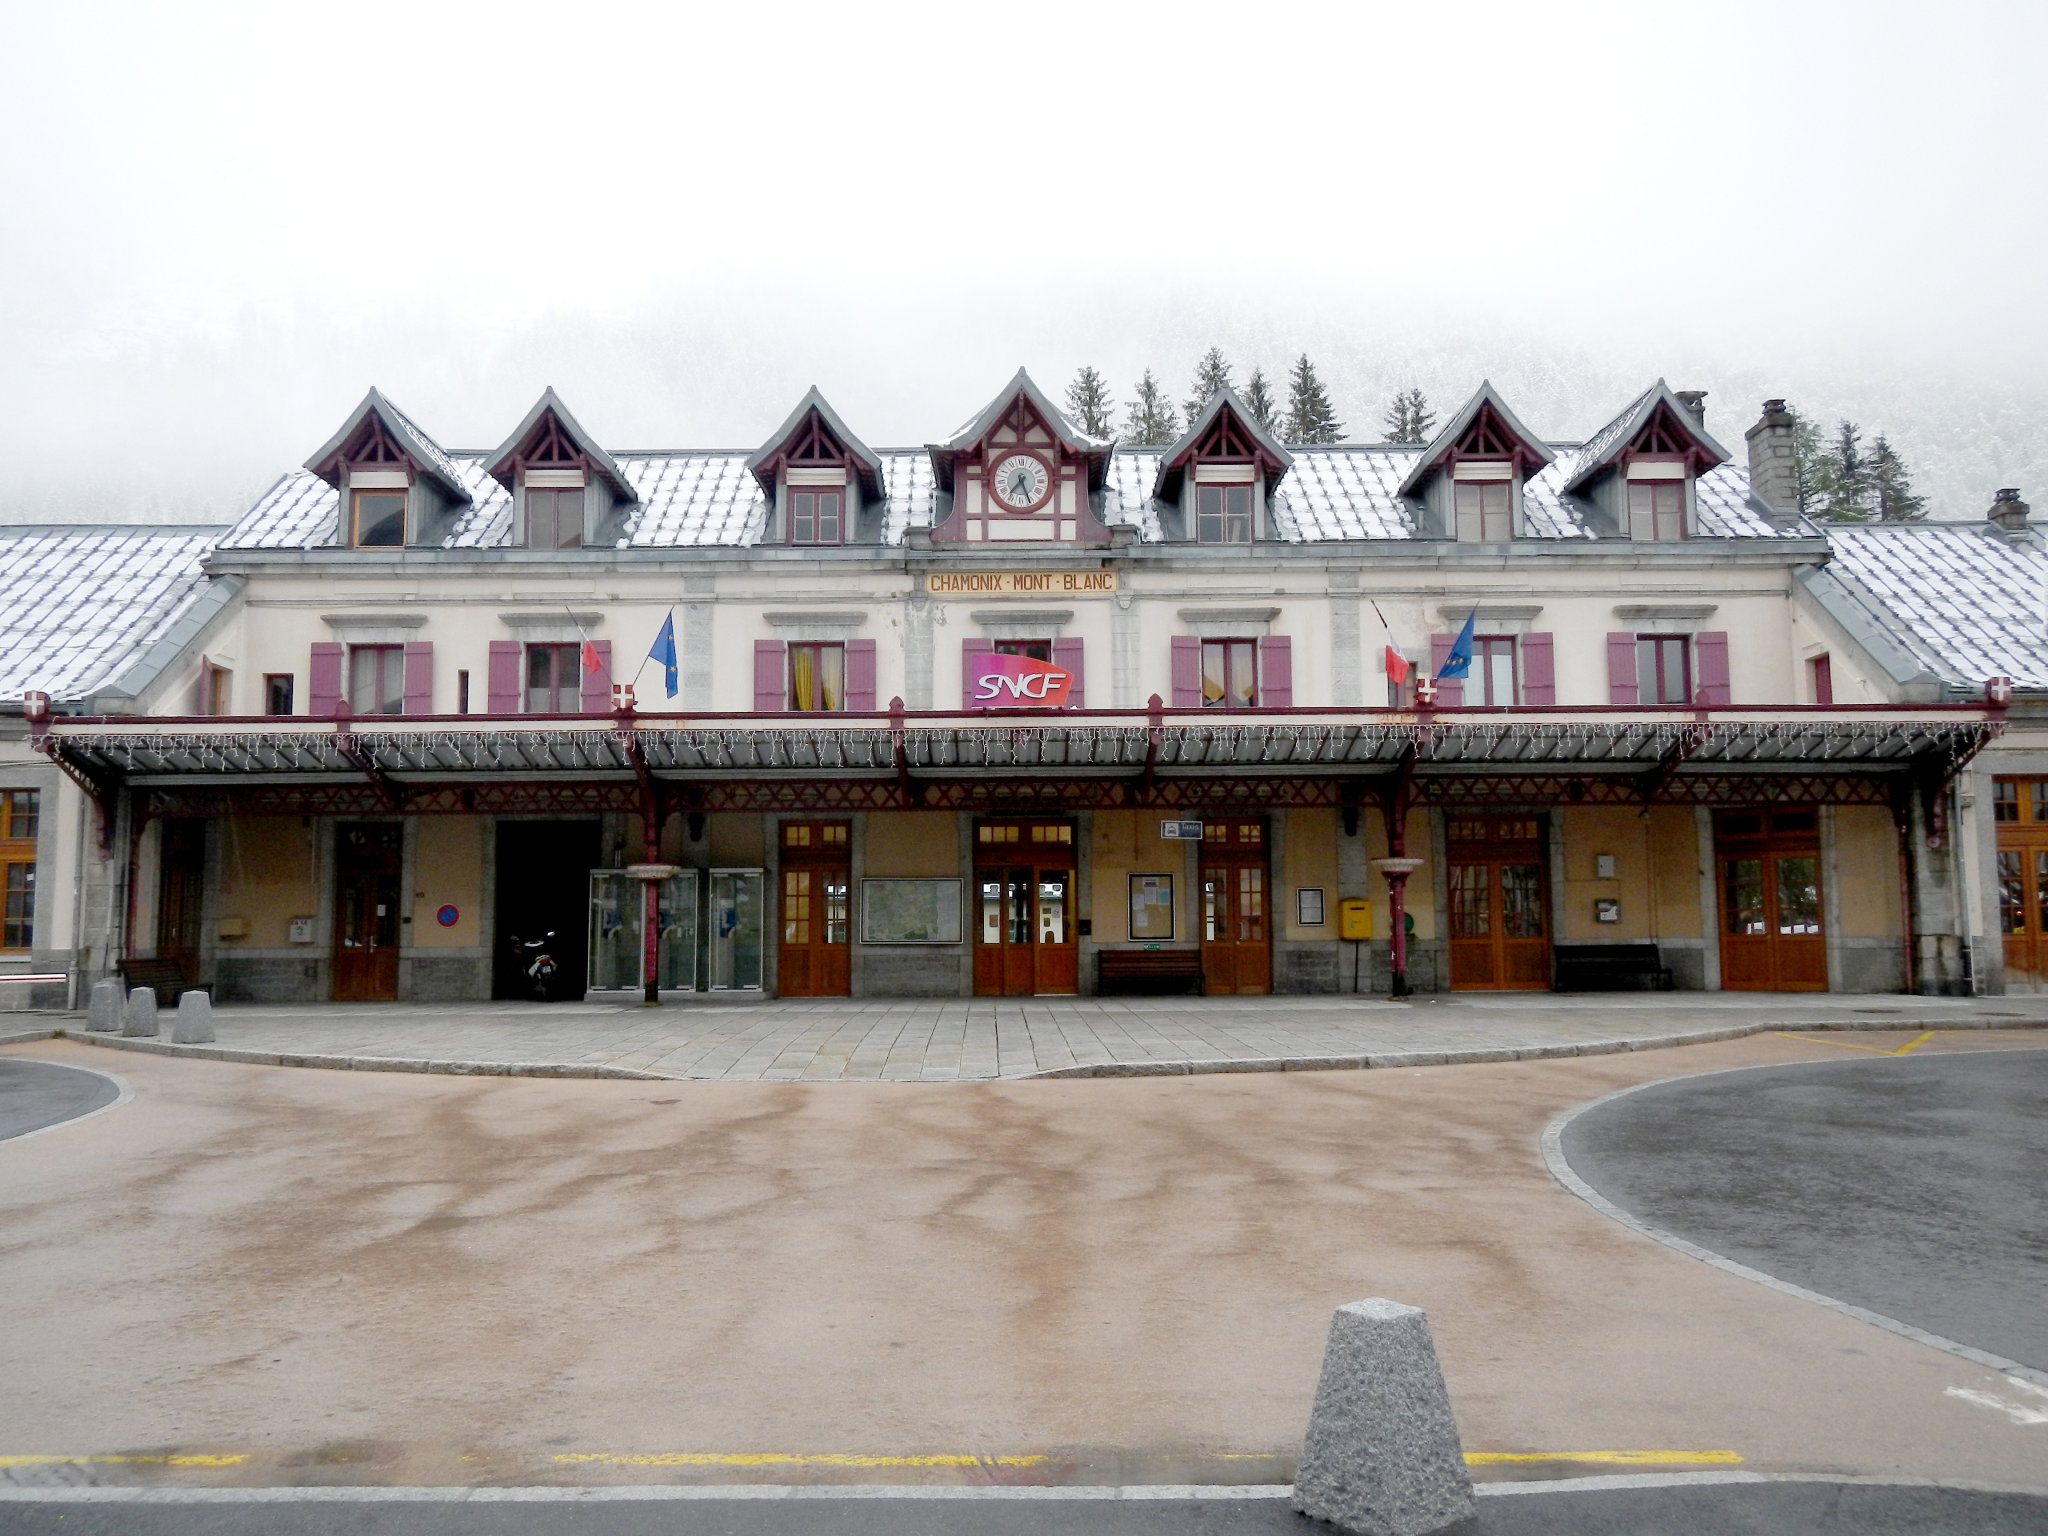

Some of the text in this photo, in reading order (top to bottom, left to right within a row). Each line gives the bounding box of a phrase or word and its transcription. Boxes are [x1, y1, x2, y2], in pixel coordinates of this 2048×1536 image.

[931, 573, 1113, 591] CHAMONIX MONT BLANC
[975, 673, 1067, 700] SNCF
